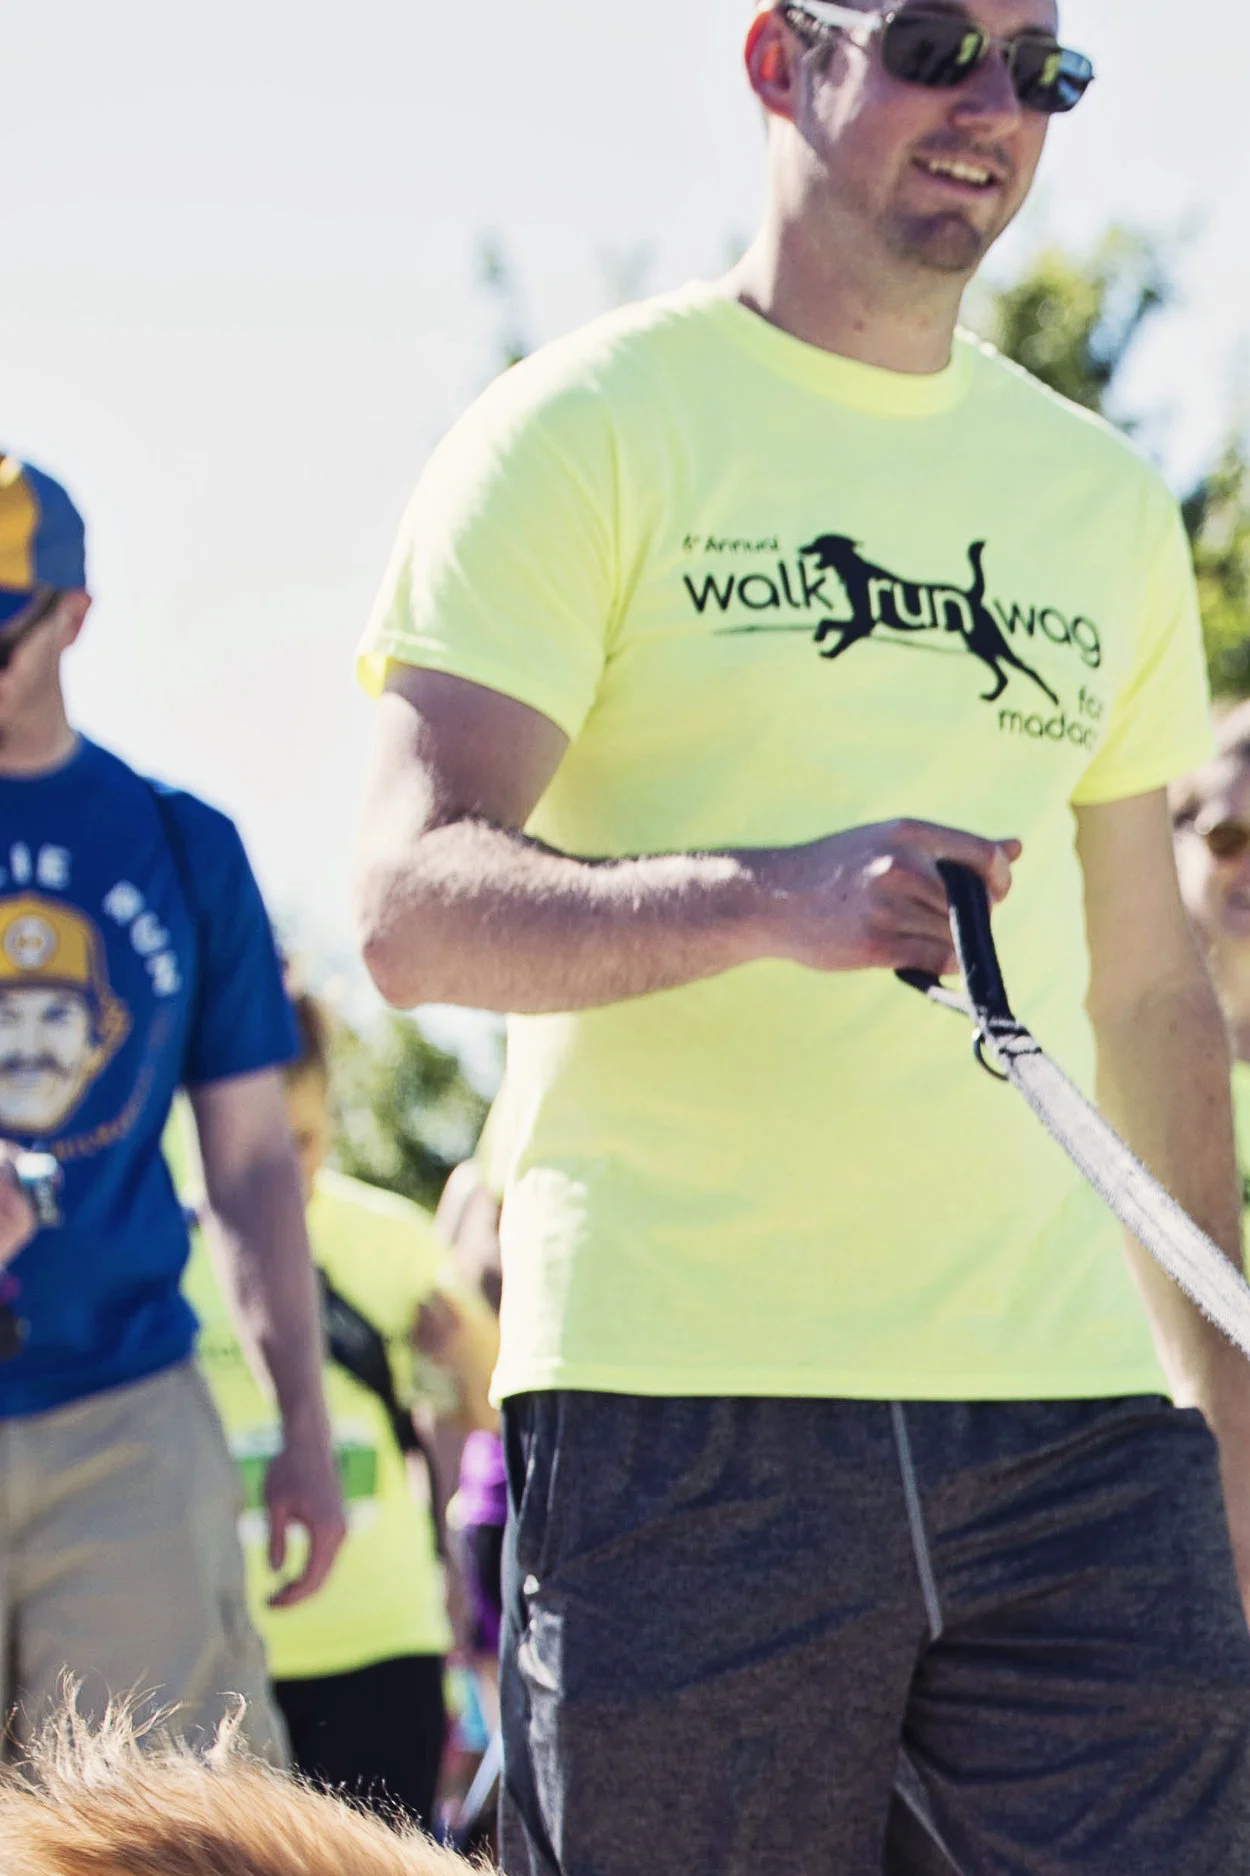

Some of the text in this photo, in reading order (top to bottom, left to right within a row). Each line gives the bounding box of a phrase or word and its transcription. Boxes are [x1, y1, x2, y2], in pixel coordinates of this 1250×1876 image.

[683, 559, 1102, 669] walk run wag
